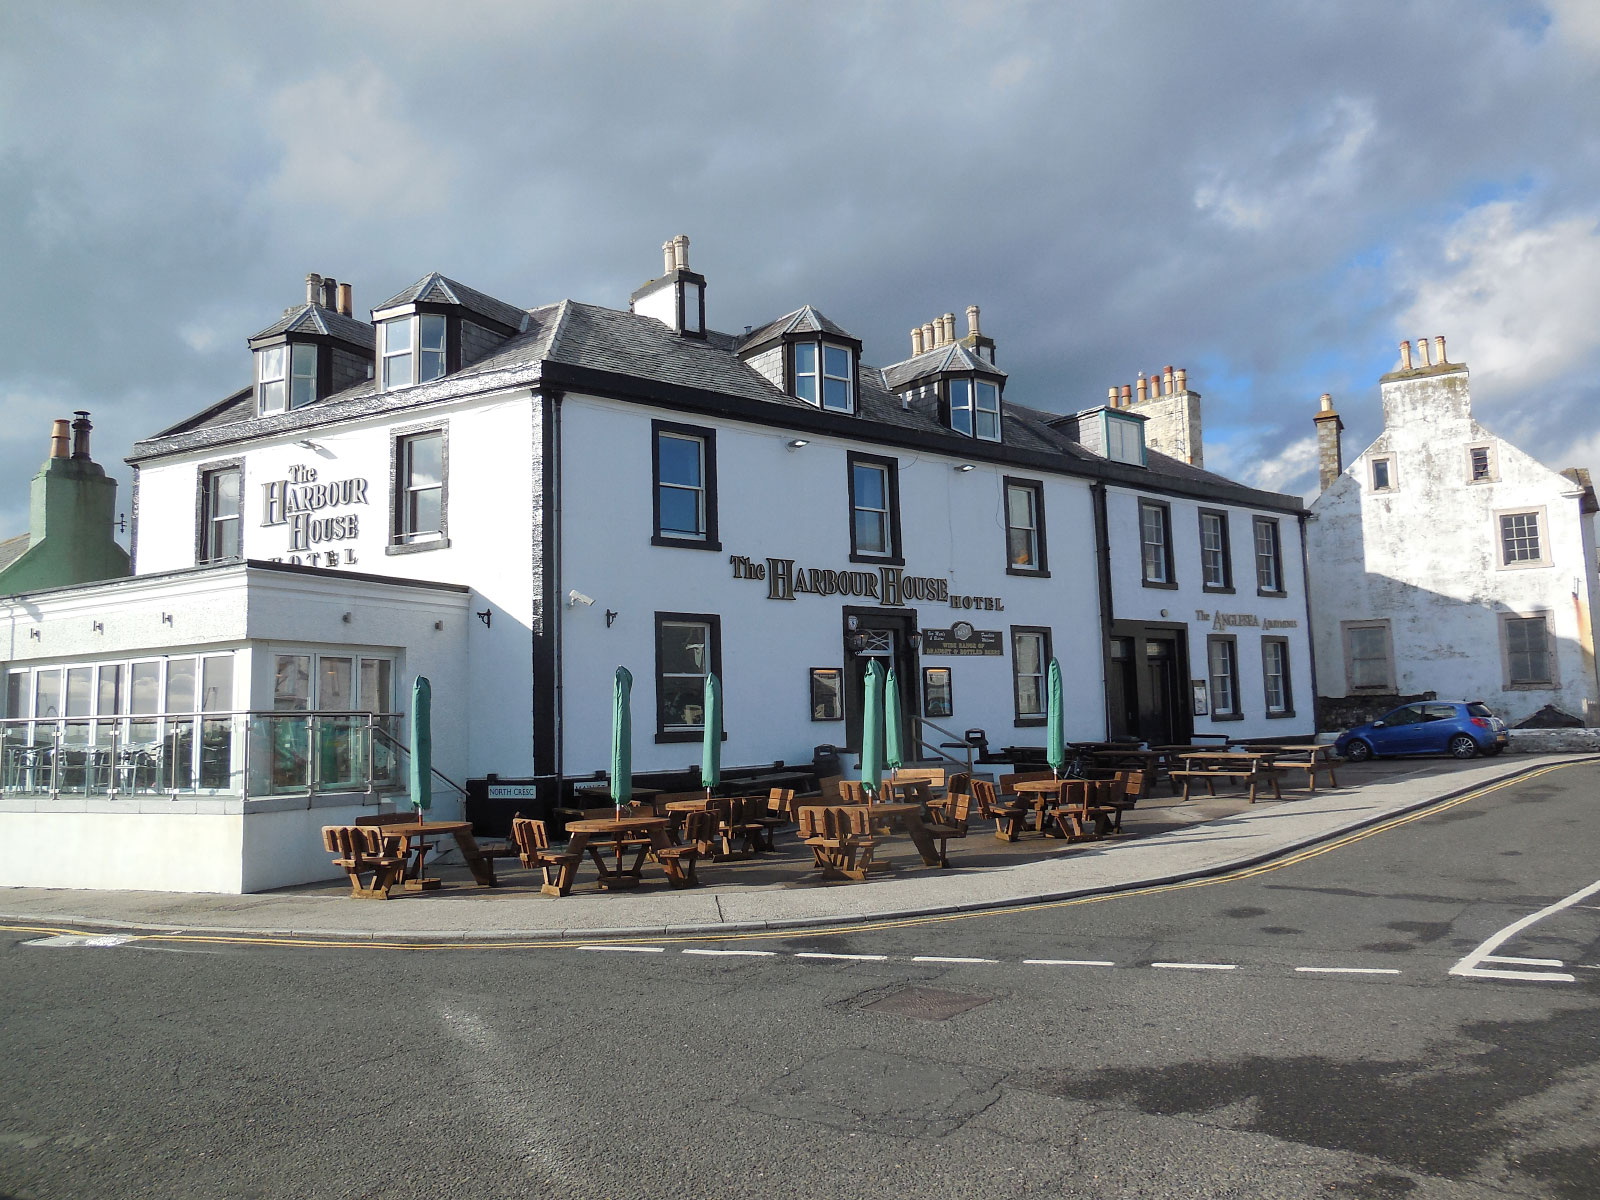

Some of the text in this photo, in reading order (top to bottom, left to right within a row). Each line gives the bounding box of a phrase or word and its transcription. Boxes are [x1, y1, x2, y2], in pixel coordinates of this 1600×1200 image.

[288, 464, 318, 485] The
[260, 478, 369, 527] HARBOUR
[287, 512, 359, 552] HOUSE
[730, 555, 1004, 611] The HARBOUR HOUSE HOTEL
[1195, 609, 1210, 621] The
[1212, 609, 1260, 631] ANGLESEA
[490, 788, 534, 796] NORTH CRESC
